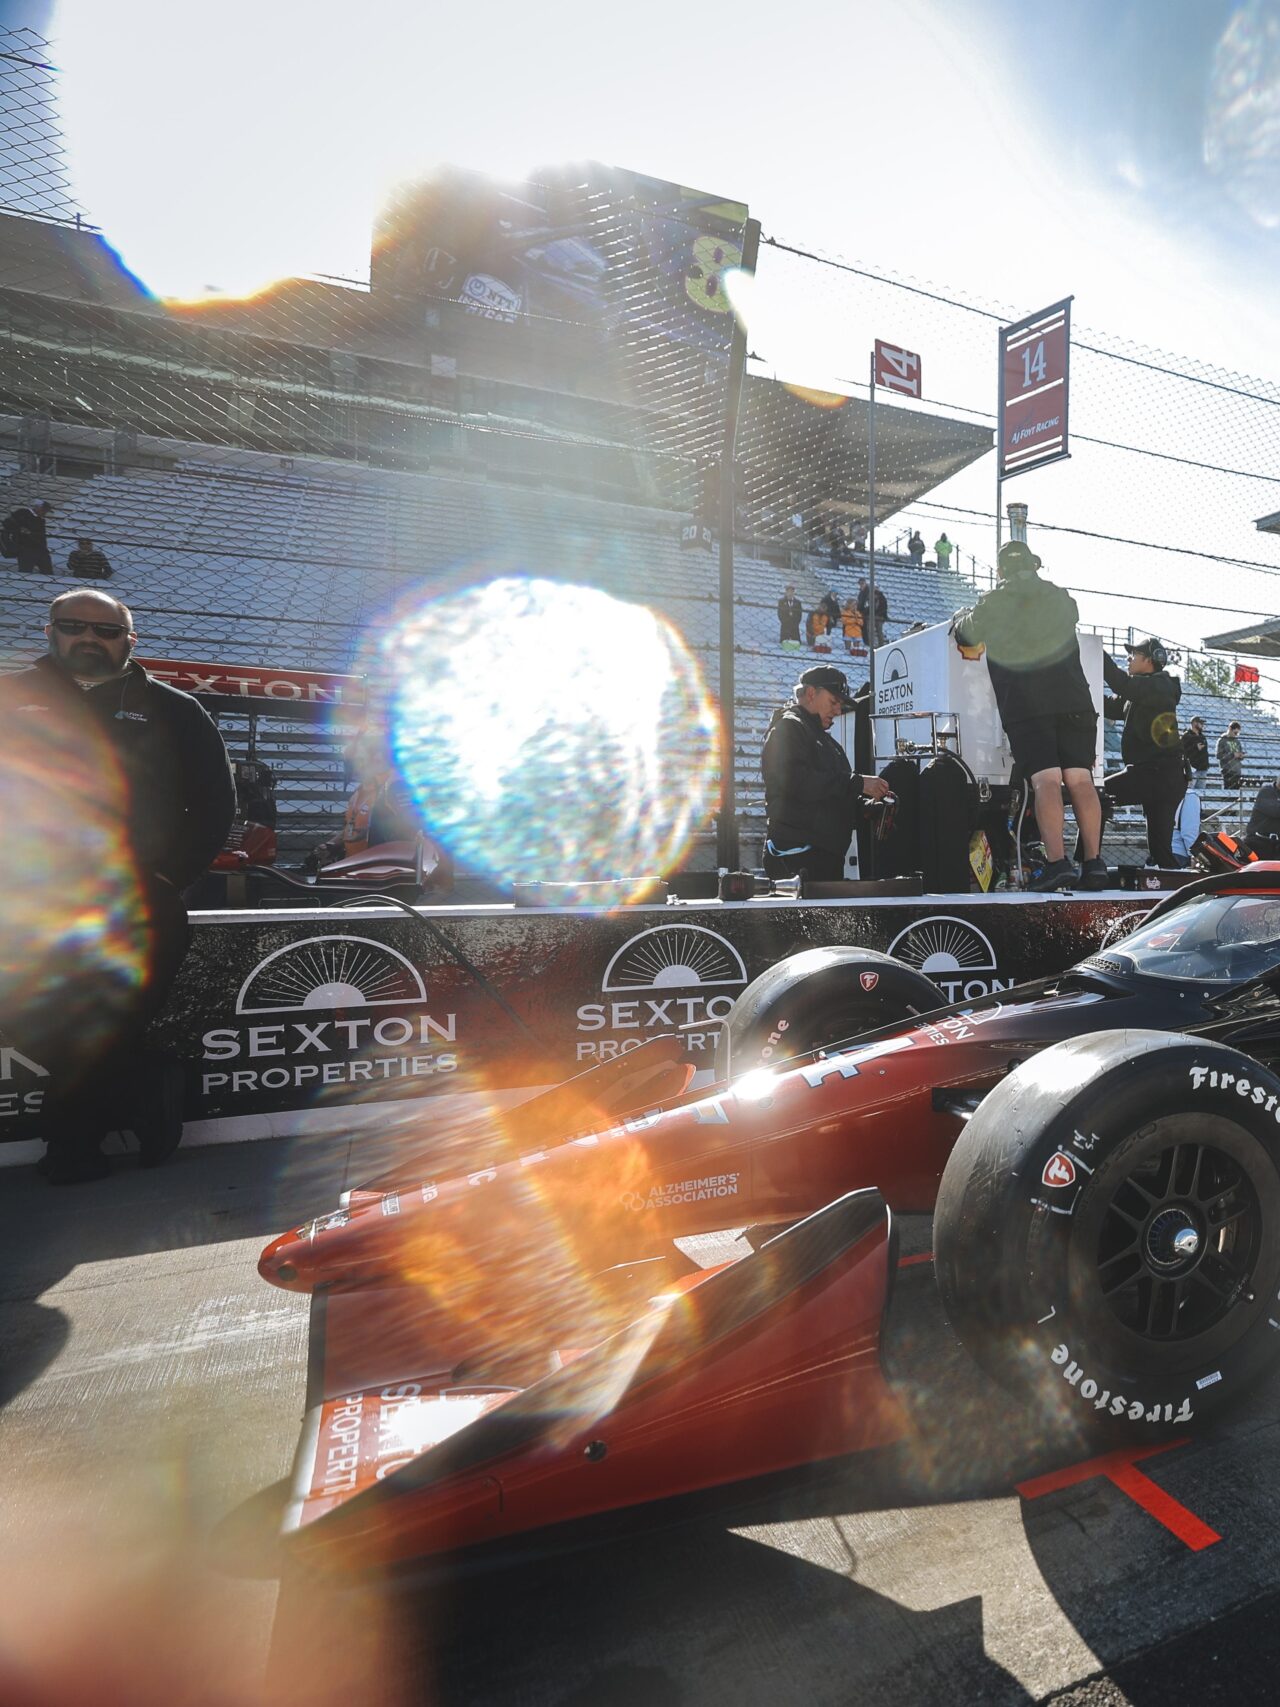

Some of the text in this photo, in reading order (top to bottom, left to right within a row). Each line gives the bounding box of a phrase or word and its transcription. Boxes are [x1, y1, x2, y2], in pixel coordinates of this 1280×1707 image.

[880, 346, 918, 396] 14
[1022, 340, 1047, 388] 14
[1011, 416, 1060, 444] AJ FOYT RACING
[879, 682, 914, 704] SEXTON
[576, 994, 736, 1032] SEXTO
[202, 1013, 457, 1061] SEXTON
[202, 1053, 458, 1095] PROPERTIES
[1072, 1129, 1088, 1150] 14
[645, 1184, 738, 1210] ASSOCIATION
[649, 1172, 738, 1198] ALZHEIMER'S
[1050, 1343, 1194, 1424] Firestone
[320, 1392, 364, 1497] PROPERTI
